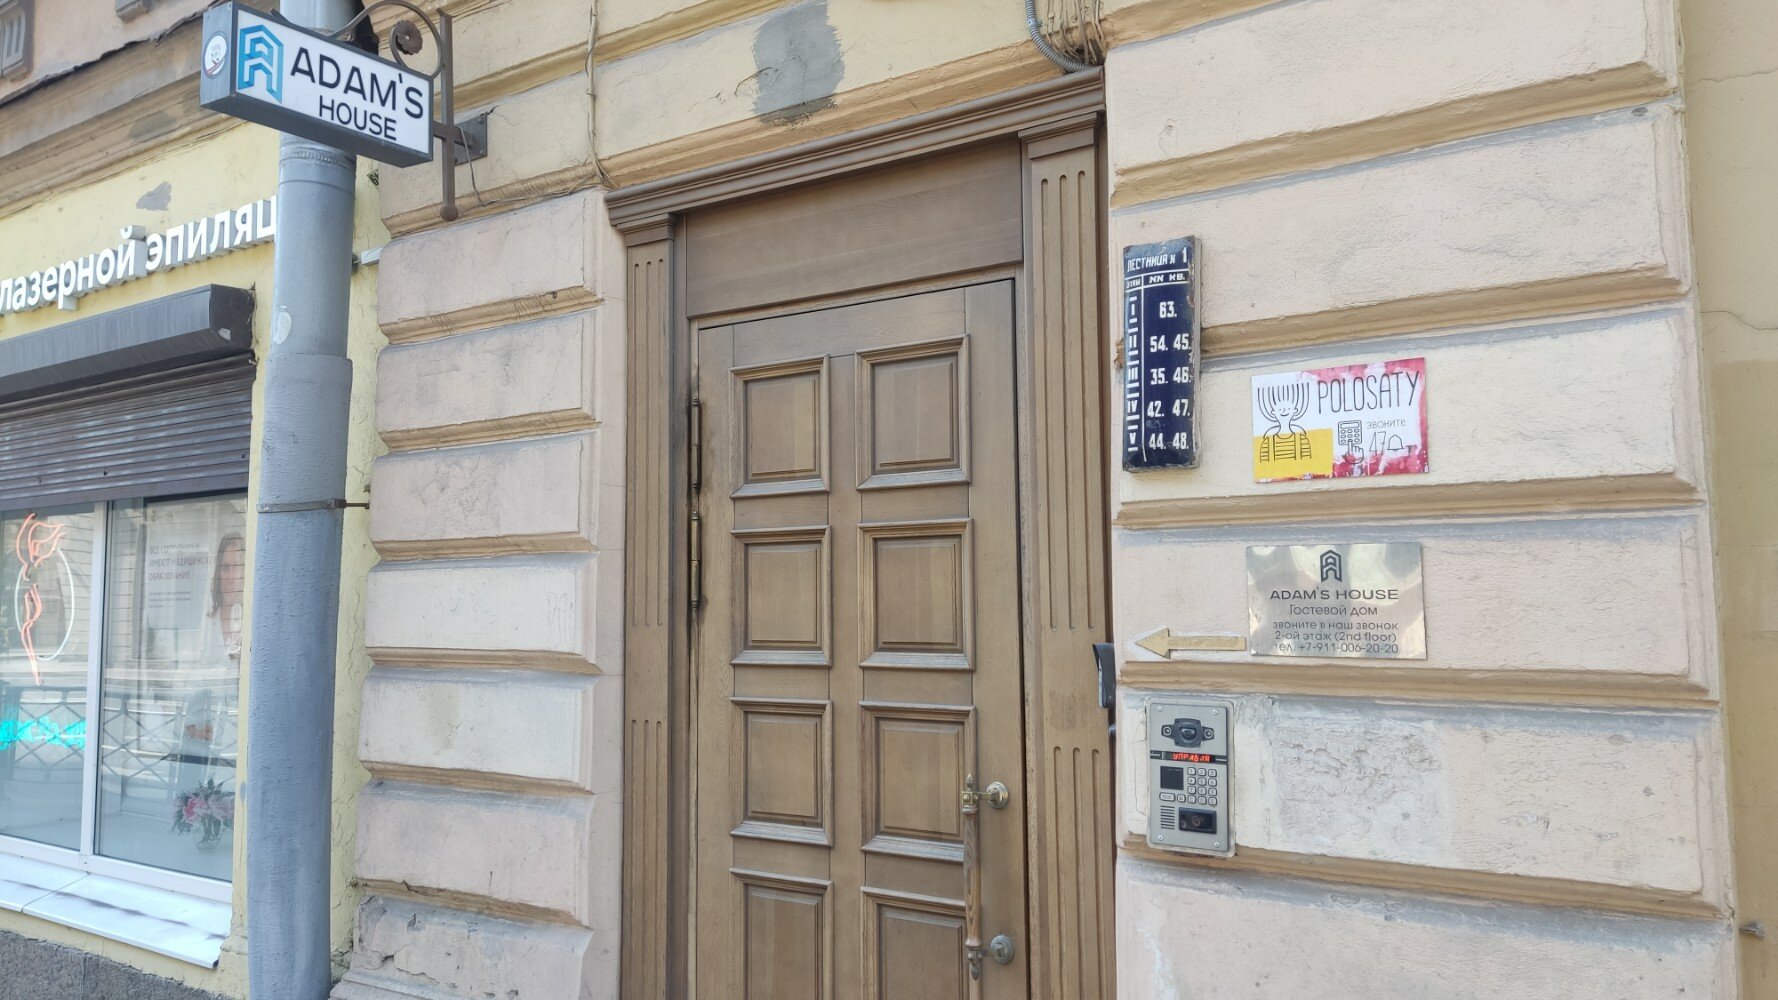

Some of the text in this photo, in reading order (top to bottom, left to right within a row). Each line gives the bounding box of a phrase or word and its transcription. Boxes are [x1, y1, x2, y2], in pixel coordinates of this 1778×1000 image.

[291, 47, 424, 119] ADAM'S
[319, 95, 397, 141] HOUSE
[1127, 254, 1168, 272] ЛЕСТНИЦА
[1182, 247, 1188, 262] 1
[0, 227, 138, 310] лазерной
[1317, 370, 1420, 414] POLOSATY
[1366, 418, 1406, 429] звоните
[1270, 586, 1399, 600] ADAM'S HOUSE
[1289, 604, 1378, 617] Гостевой дом
[1272, 621, 1316, 630] звоните
[1328, 622, 1354, 630] наш
[1356, 622, 1398, 630] звонок
[1275, 630, 1398, 642] 2-ой этаж (2nd floor)
[1274, 642, 1399, 654] тел. +7-911-006-20-20
